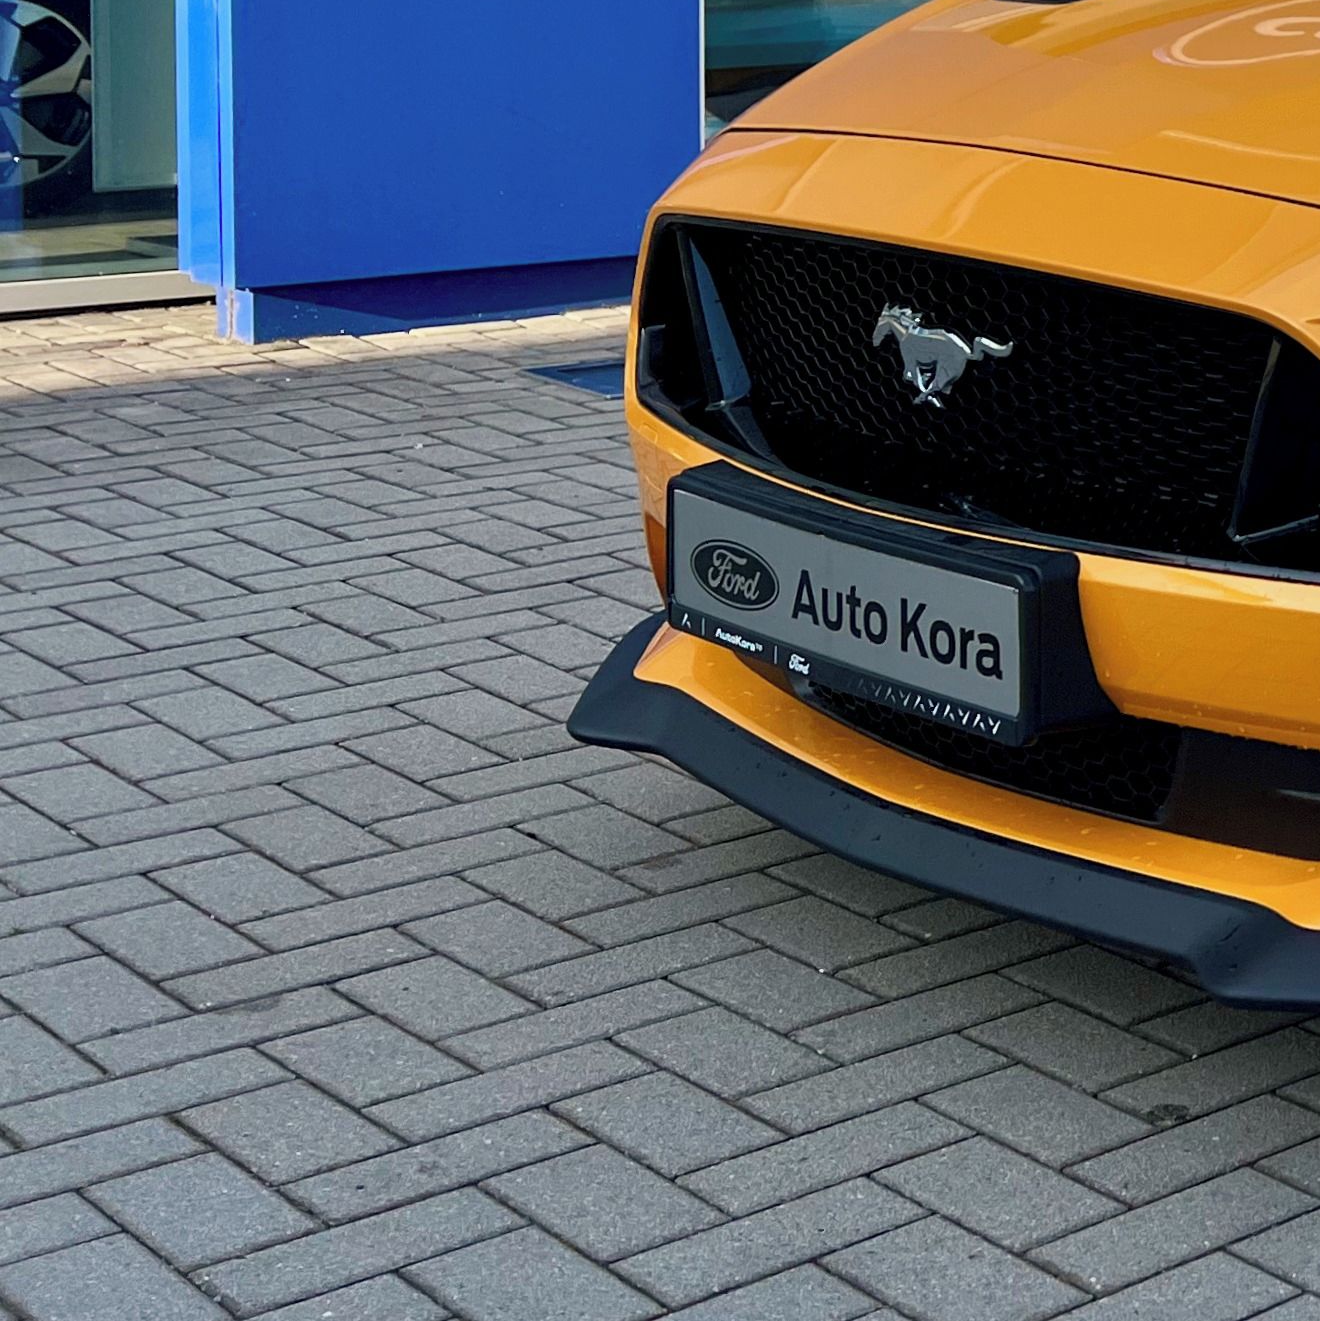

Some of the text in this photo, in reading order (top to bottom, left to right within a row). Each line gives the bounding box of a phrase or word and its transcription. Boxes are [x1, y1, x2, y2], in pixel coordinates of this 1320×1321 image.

[707, 548, 761, 601] Ford
[791, 569, 1004, 680] Auto Kora
[788, 653, 810, 675] Ford
